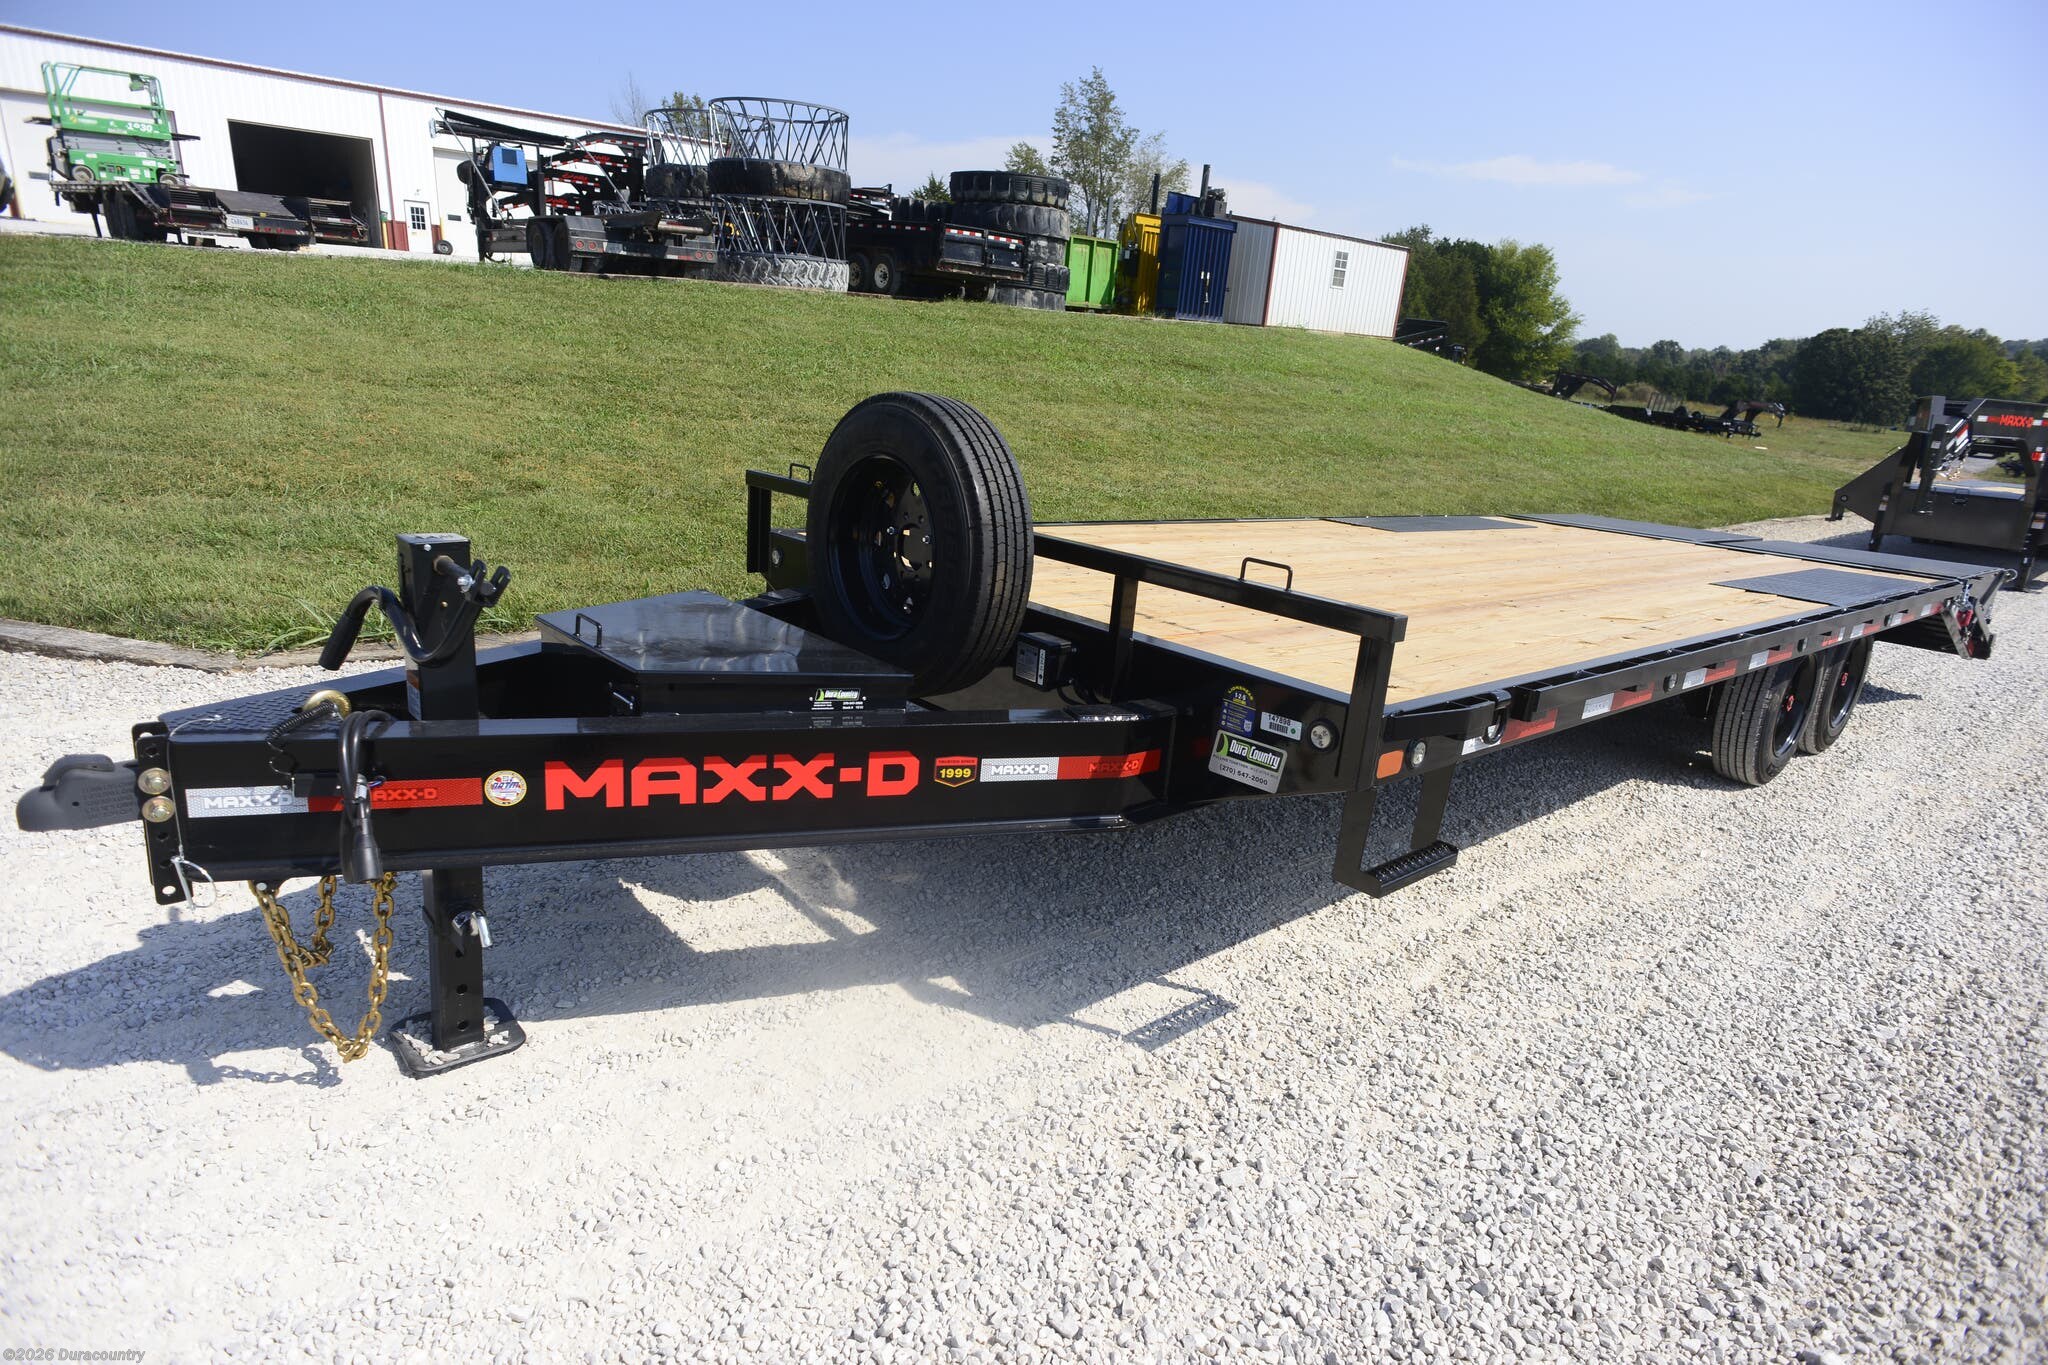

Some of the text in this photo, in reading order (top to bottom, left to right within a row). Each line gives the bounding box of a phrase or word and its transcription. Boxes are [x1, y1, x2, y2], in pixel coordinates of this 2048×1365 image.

[1229, 739, 1281, 770] Dura Country
[939, 767, 972, 779] 1999
[991, 763, 1050, 775] MAXX-D
[1088, 759, 1139, 773] MAXX-D
[544, 751, 920, 811] MAXX-D
[1219, 764, 1236, 776] (270)
[1237, 770, 1268, 786] 547-2000
[203, 793, 293, 810] MAXX-D
[372, 788, 438, 802] AXX-D
